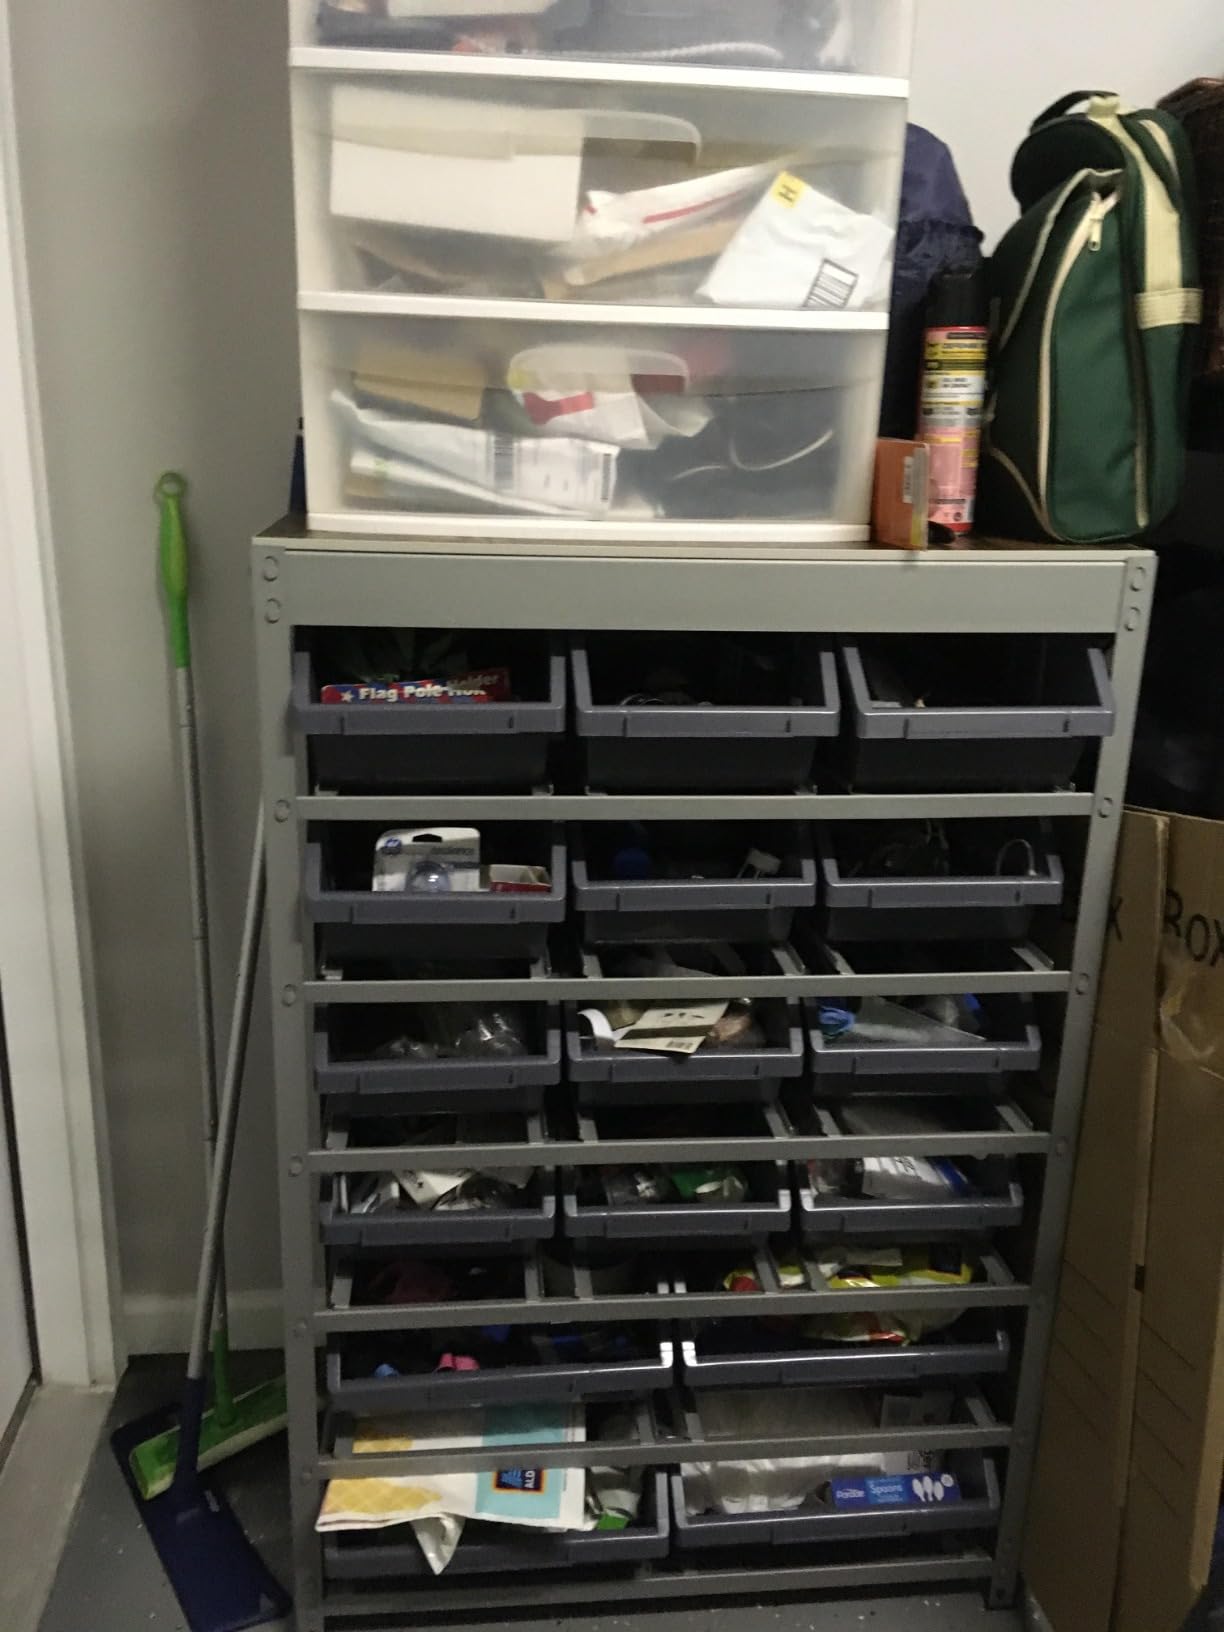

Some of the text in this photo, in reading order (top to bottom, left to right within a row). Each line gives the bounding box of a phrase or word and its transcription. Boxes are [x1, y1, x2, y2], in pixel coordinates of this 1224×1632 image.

[778, 184, 799, 204] H
[358, 686, 398, 703] Flag
[523, 1469, 537, 1489] ALD
